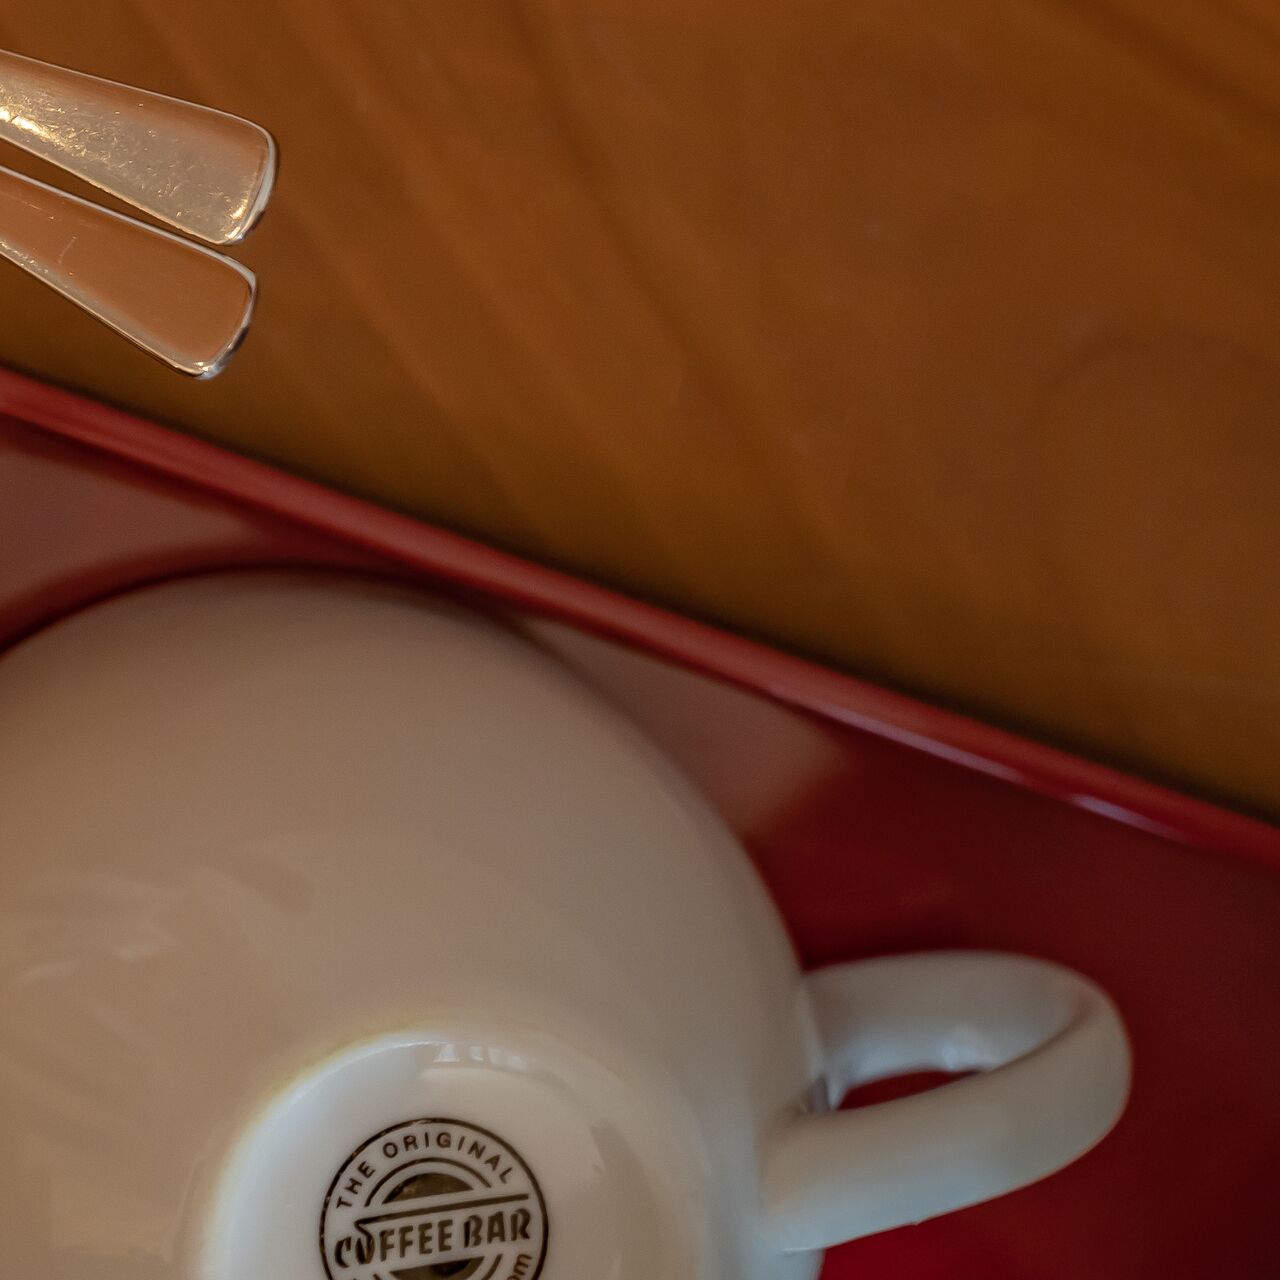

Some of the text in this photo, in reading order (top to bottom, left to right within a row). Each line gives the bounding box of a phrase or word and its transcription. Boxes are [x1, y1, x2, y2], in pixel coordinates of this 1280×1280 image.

[336, 1131, 516, 1209] THE ORIGINAL
[333, 1219, 454, 1269] COFFEE
[463, 1207, 532, 1249] BAR
